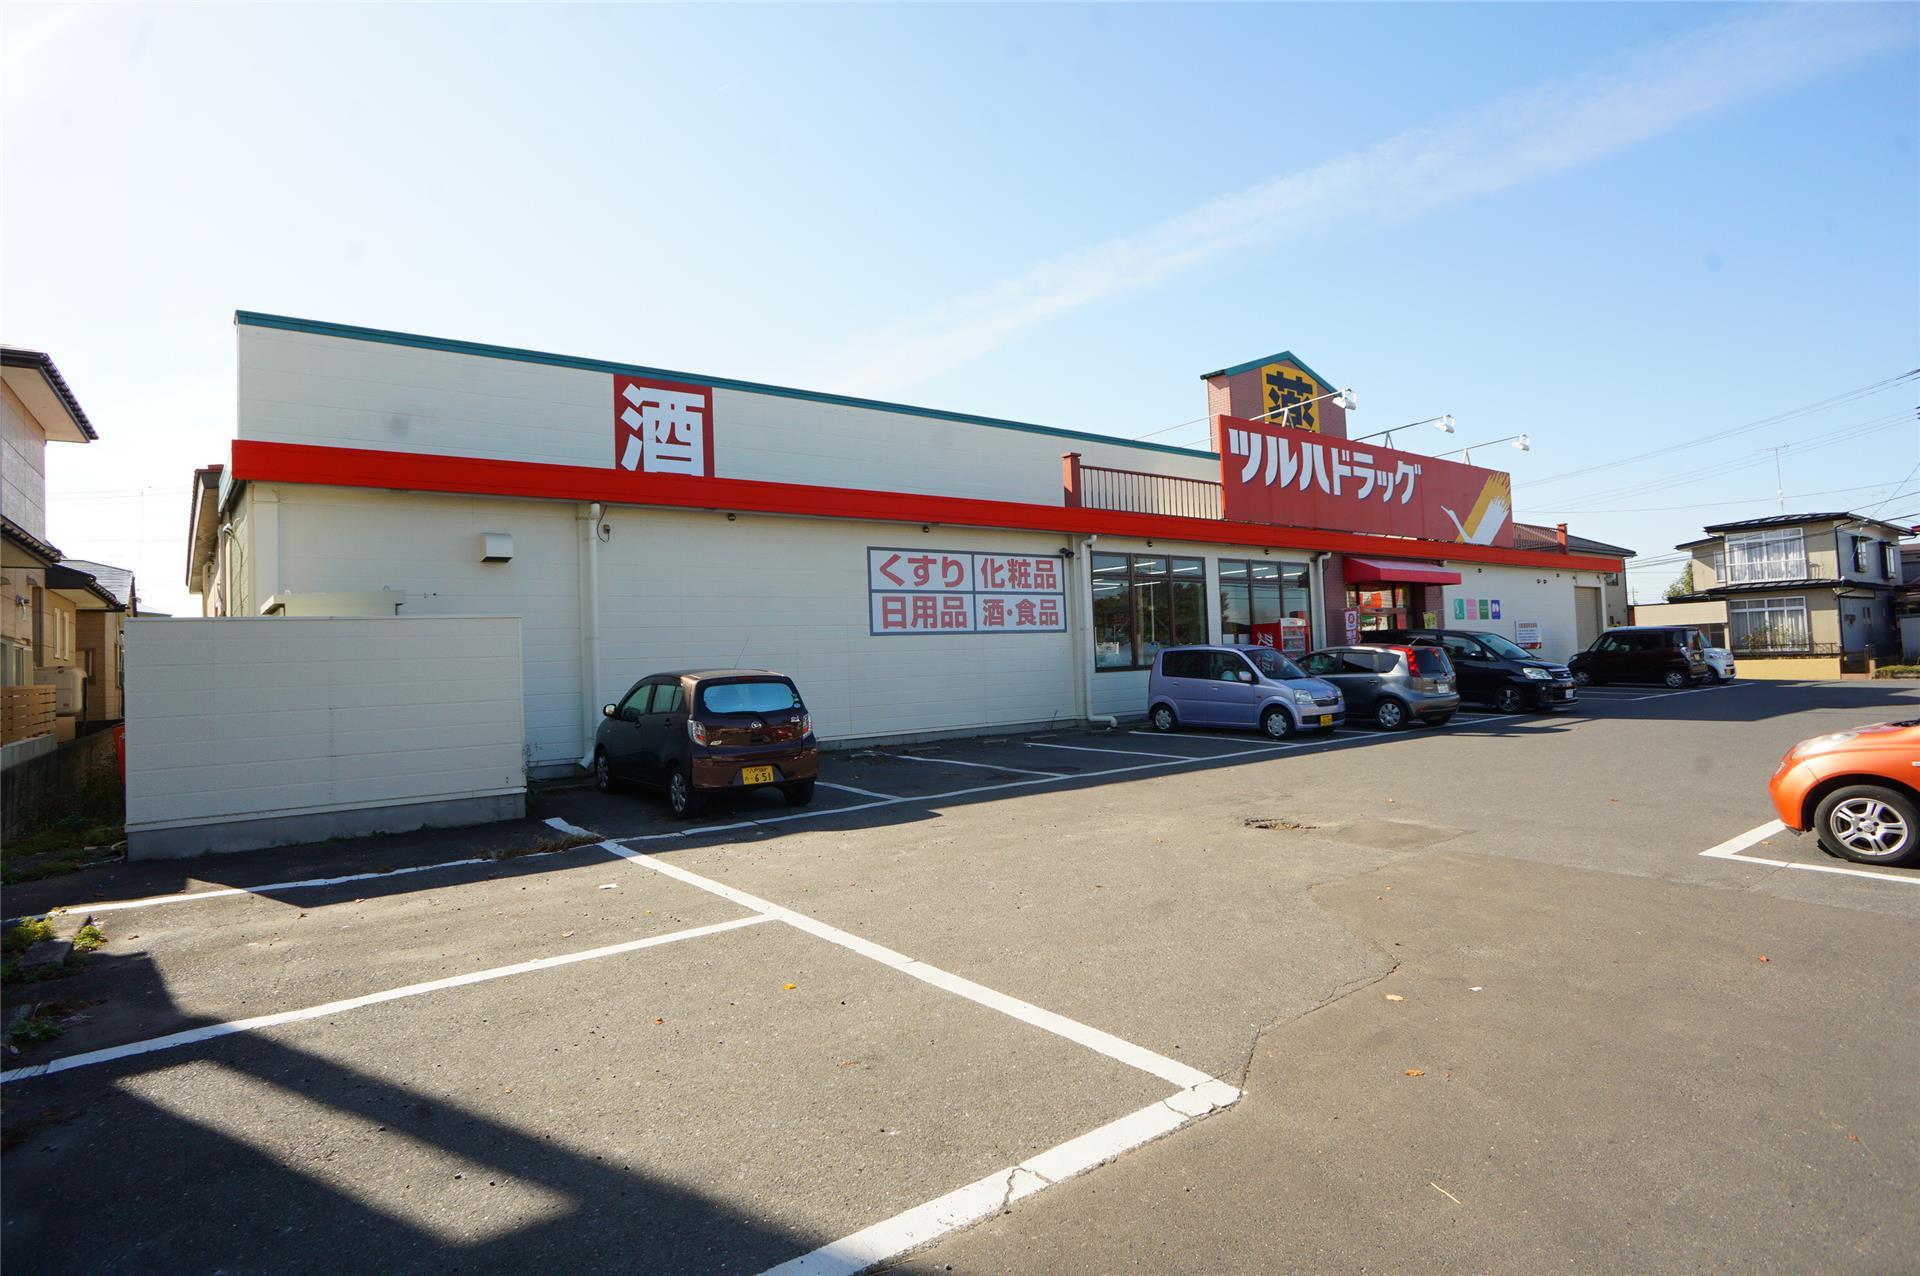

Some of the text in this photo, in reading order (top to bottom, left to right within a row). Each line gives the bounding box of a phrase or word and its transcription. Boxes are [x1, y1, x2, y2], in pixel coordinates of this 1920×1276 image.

[620, 383, 705, 476] 酒
[1228, 428, 1422, 505] ツルハドラッグ
[879, 553, 965, 588] くすり
[980, 557, 1057, 590] 化粧品
[881, 596, 967, 629] 日用品
[982, 598, 1059, 627] 酒・食品
